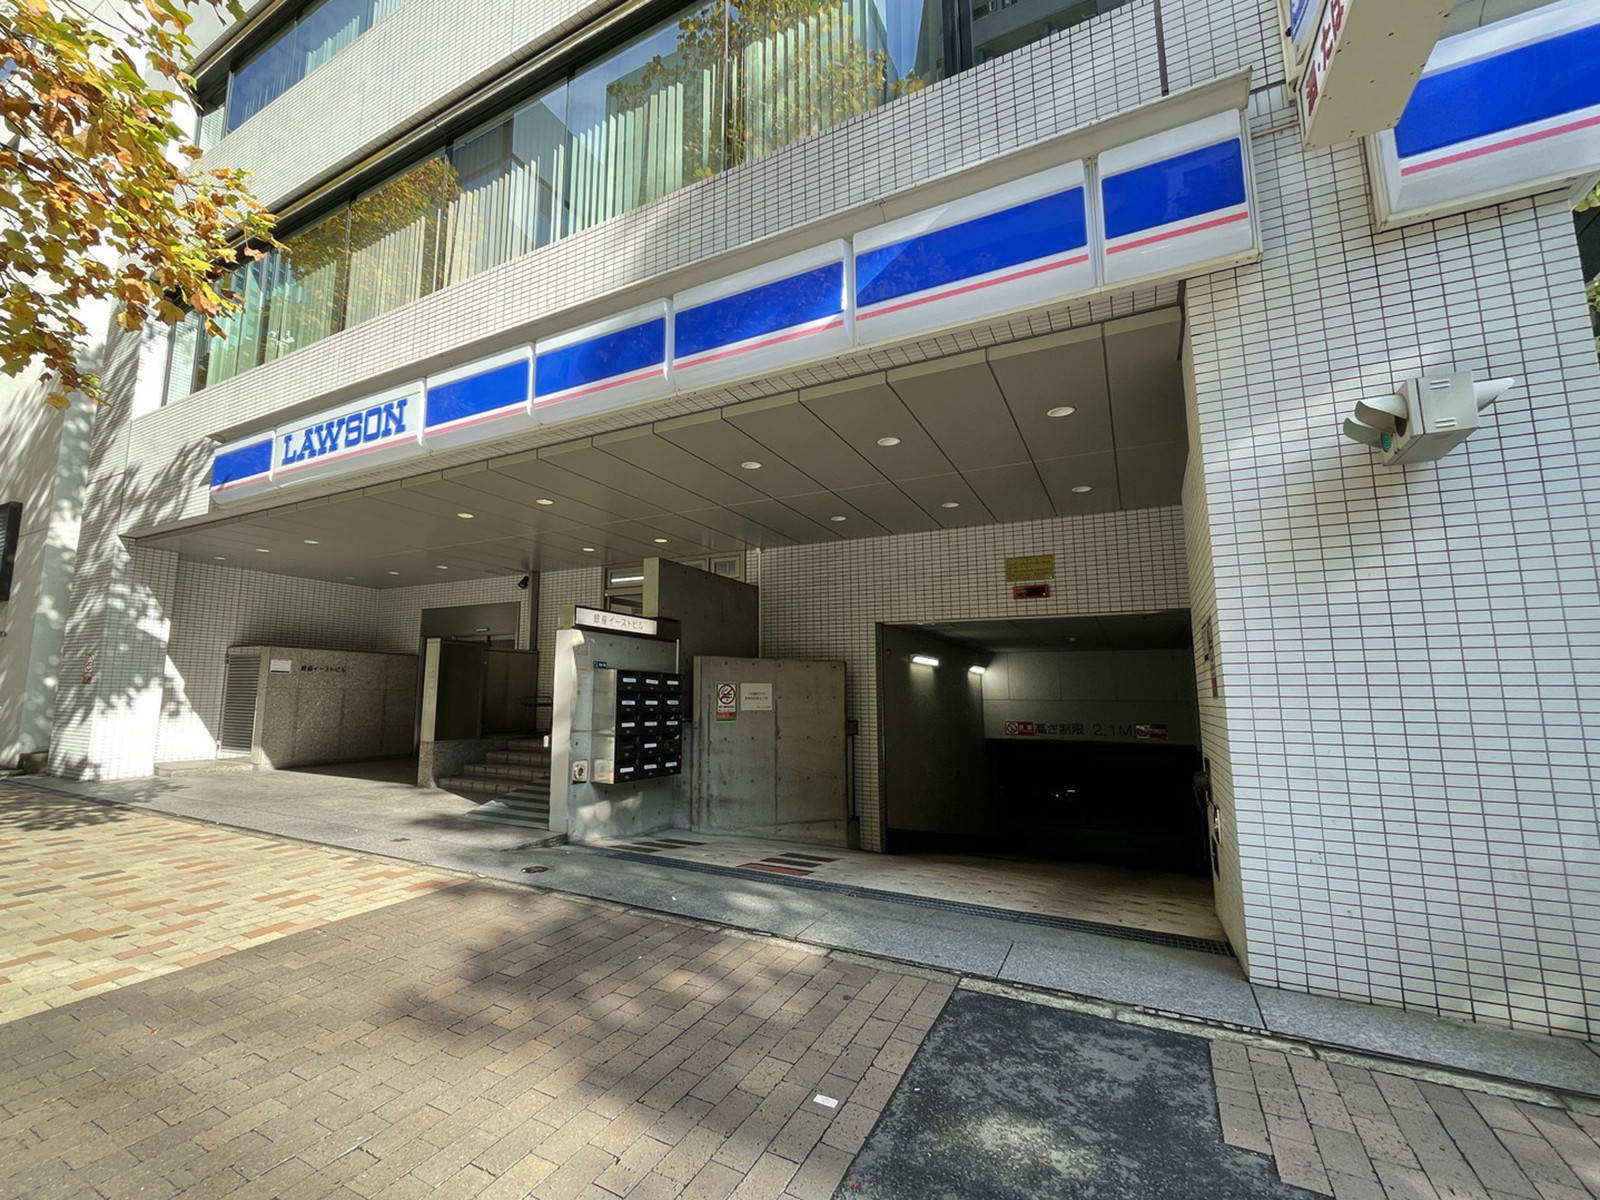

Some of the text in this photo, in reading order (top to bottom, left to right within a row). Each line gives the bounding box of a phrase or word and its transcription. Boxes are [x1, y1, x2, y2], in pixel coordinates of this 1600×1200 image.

[282, 399, 408, 465] LAWSON
[1035, 723, 1084, 736] 高さ制限
